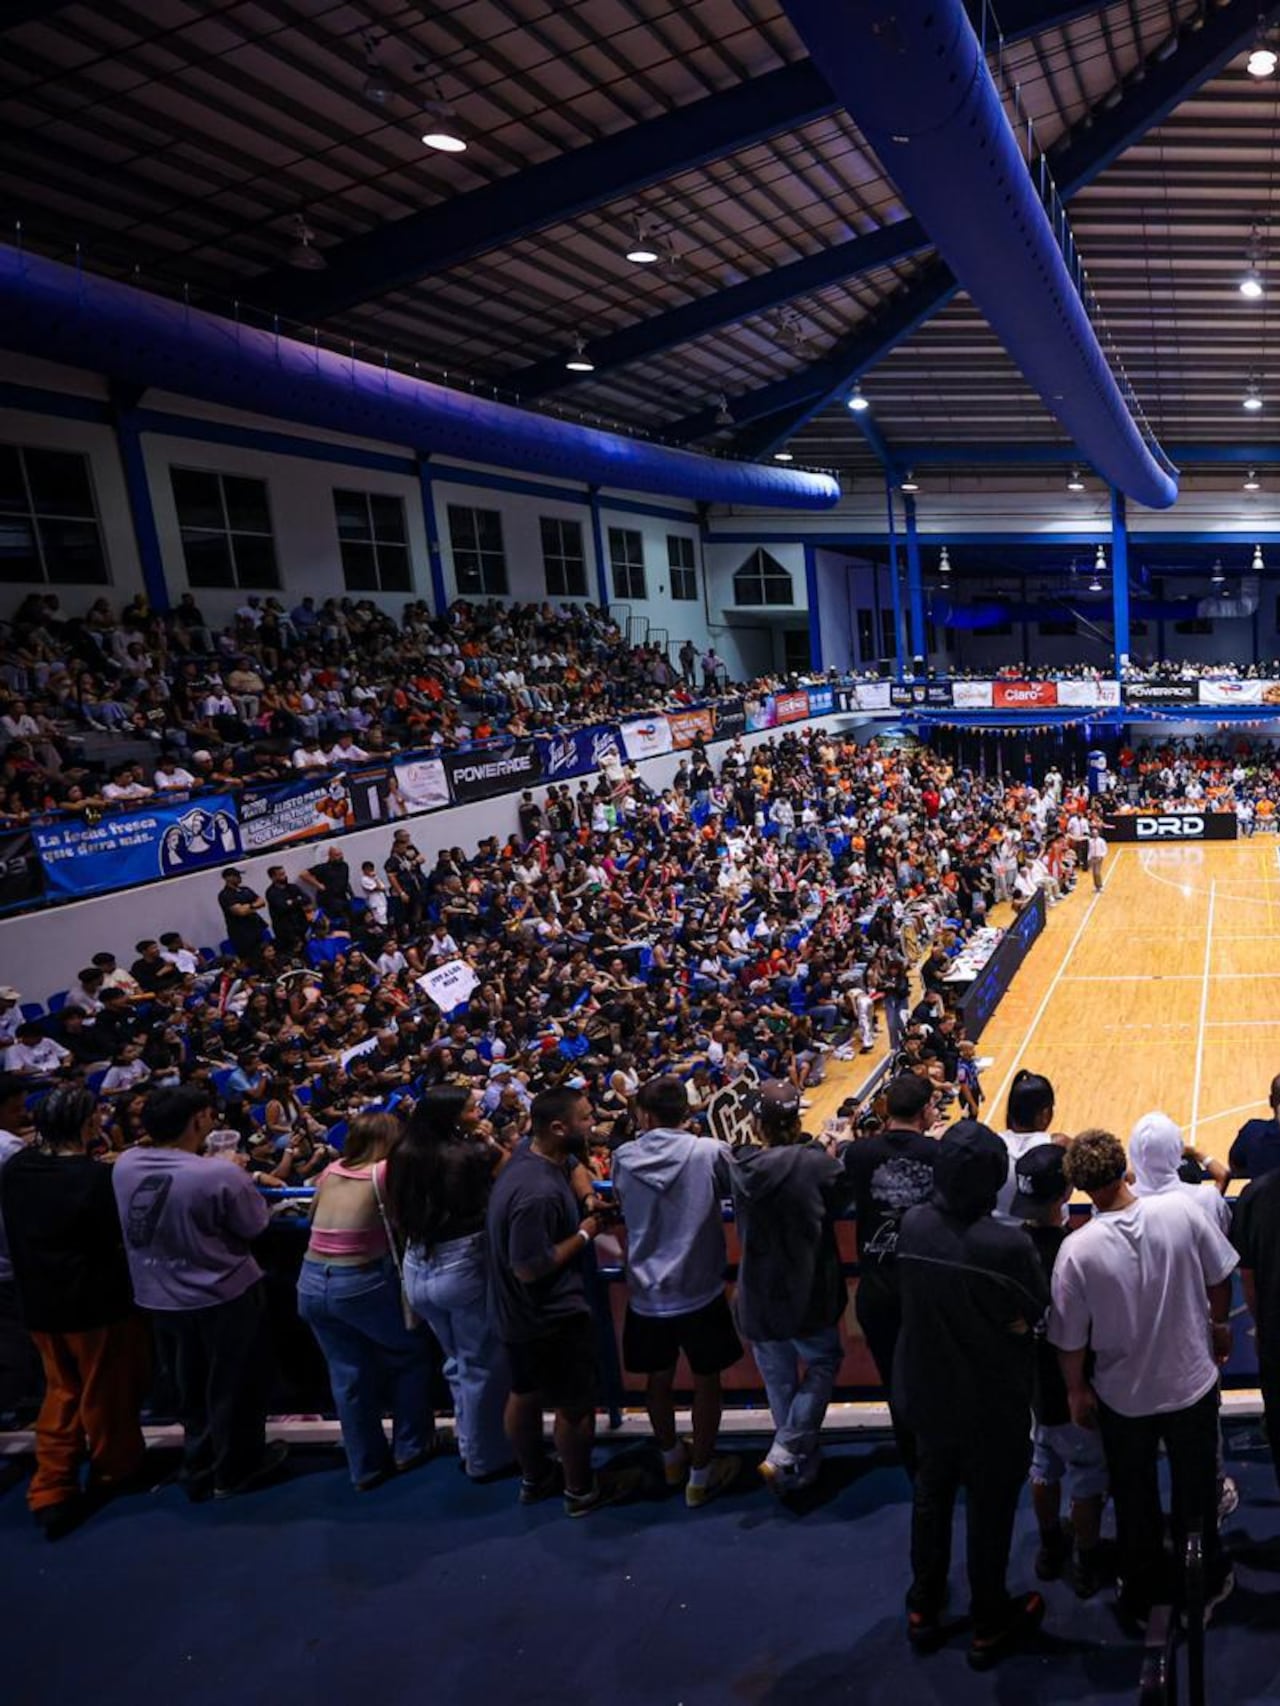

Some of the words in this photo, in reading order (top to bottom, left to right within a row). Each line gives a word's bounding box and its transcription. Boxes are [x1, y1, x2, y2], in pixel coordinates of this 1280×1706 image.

[1004, 688, 1038, 701] Claro
[453, 756, 532, 785] POWERADE
[64, 826, 108, 844] leche
[108, 817, 158, 836] fresca
[1136, 816, 1205, 836] DRD
[42, 847, 75, 864] que
[77, 838, 117, 857] dura
